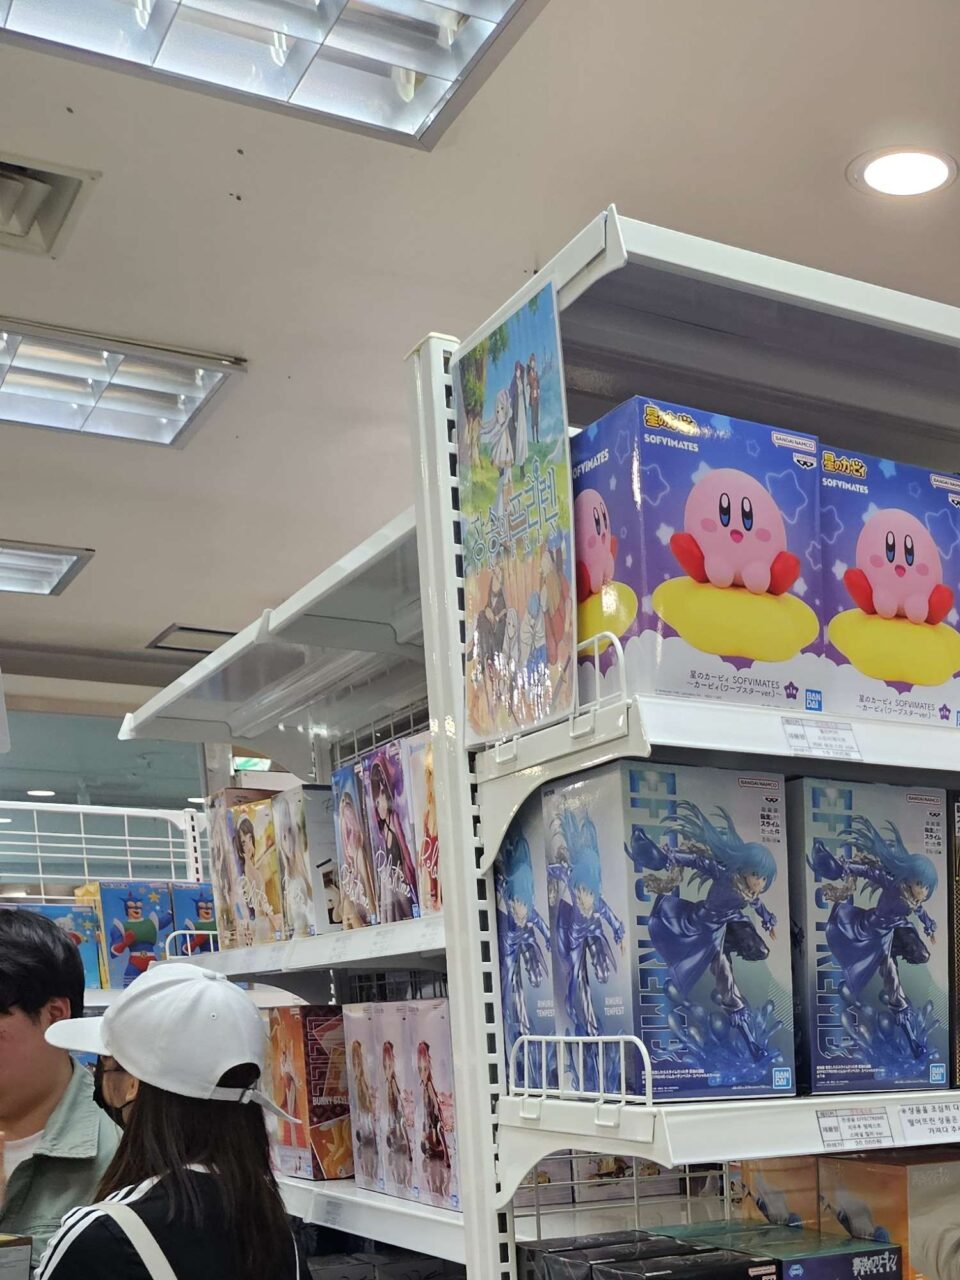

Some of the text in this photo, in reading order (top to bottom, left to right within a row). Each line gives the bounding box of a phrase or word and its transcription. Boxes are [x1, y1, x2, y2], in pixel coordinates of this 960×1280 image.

[644, 434, 699, 453] SOFVIMATES
[572, 449, 609, 479] OFVIMATES
[822, 478, 868, 494] SOFVIMATES
[733, 675, 780, 690] SOFVIMATES
[895, 699, 935, 711] SOFVIMATES
[604, 1006, 624, 1015] TEMPEST
[938, 1116, 957, 1125] 상품은
